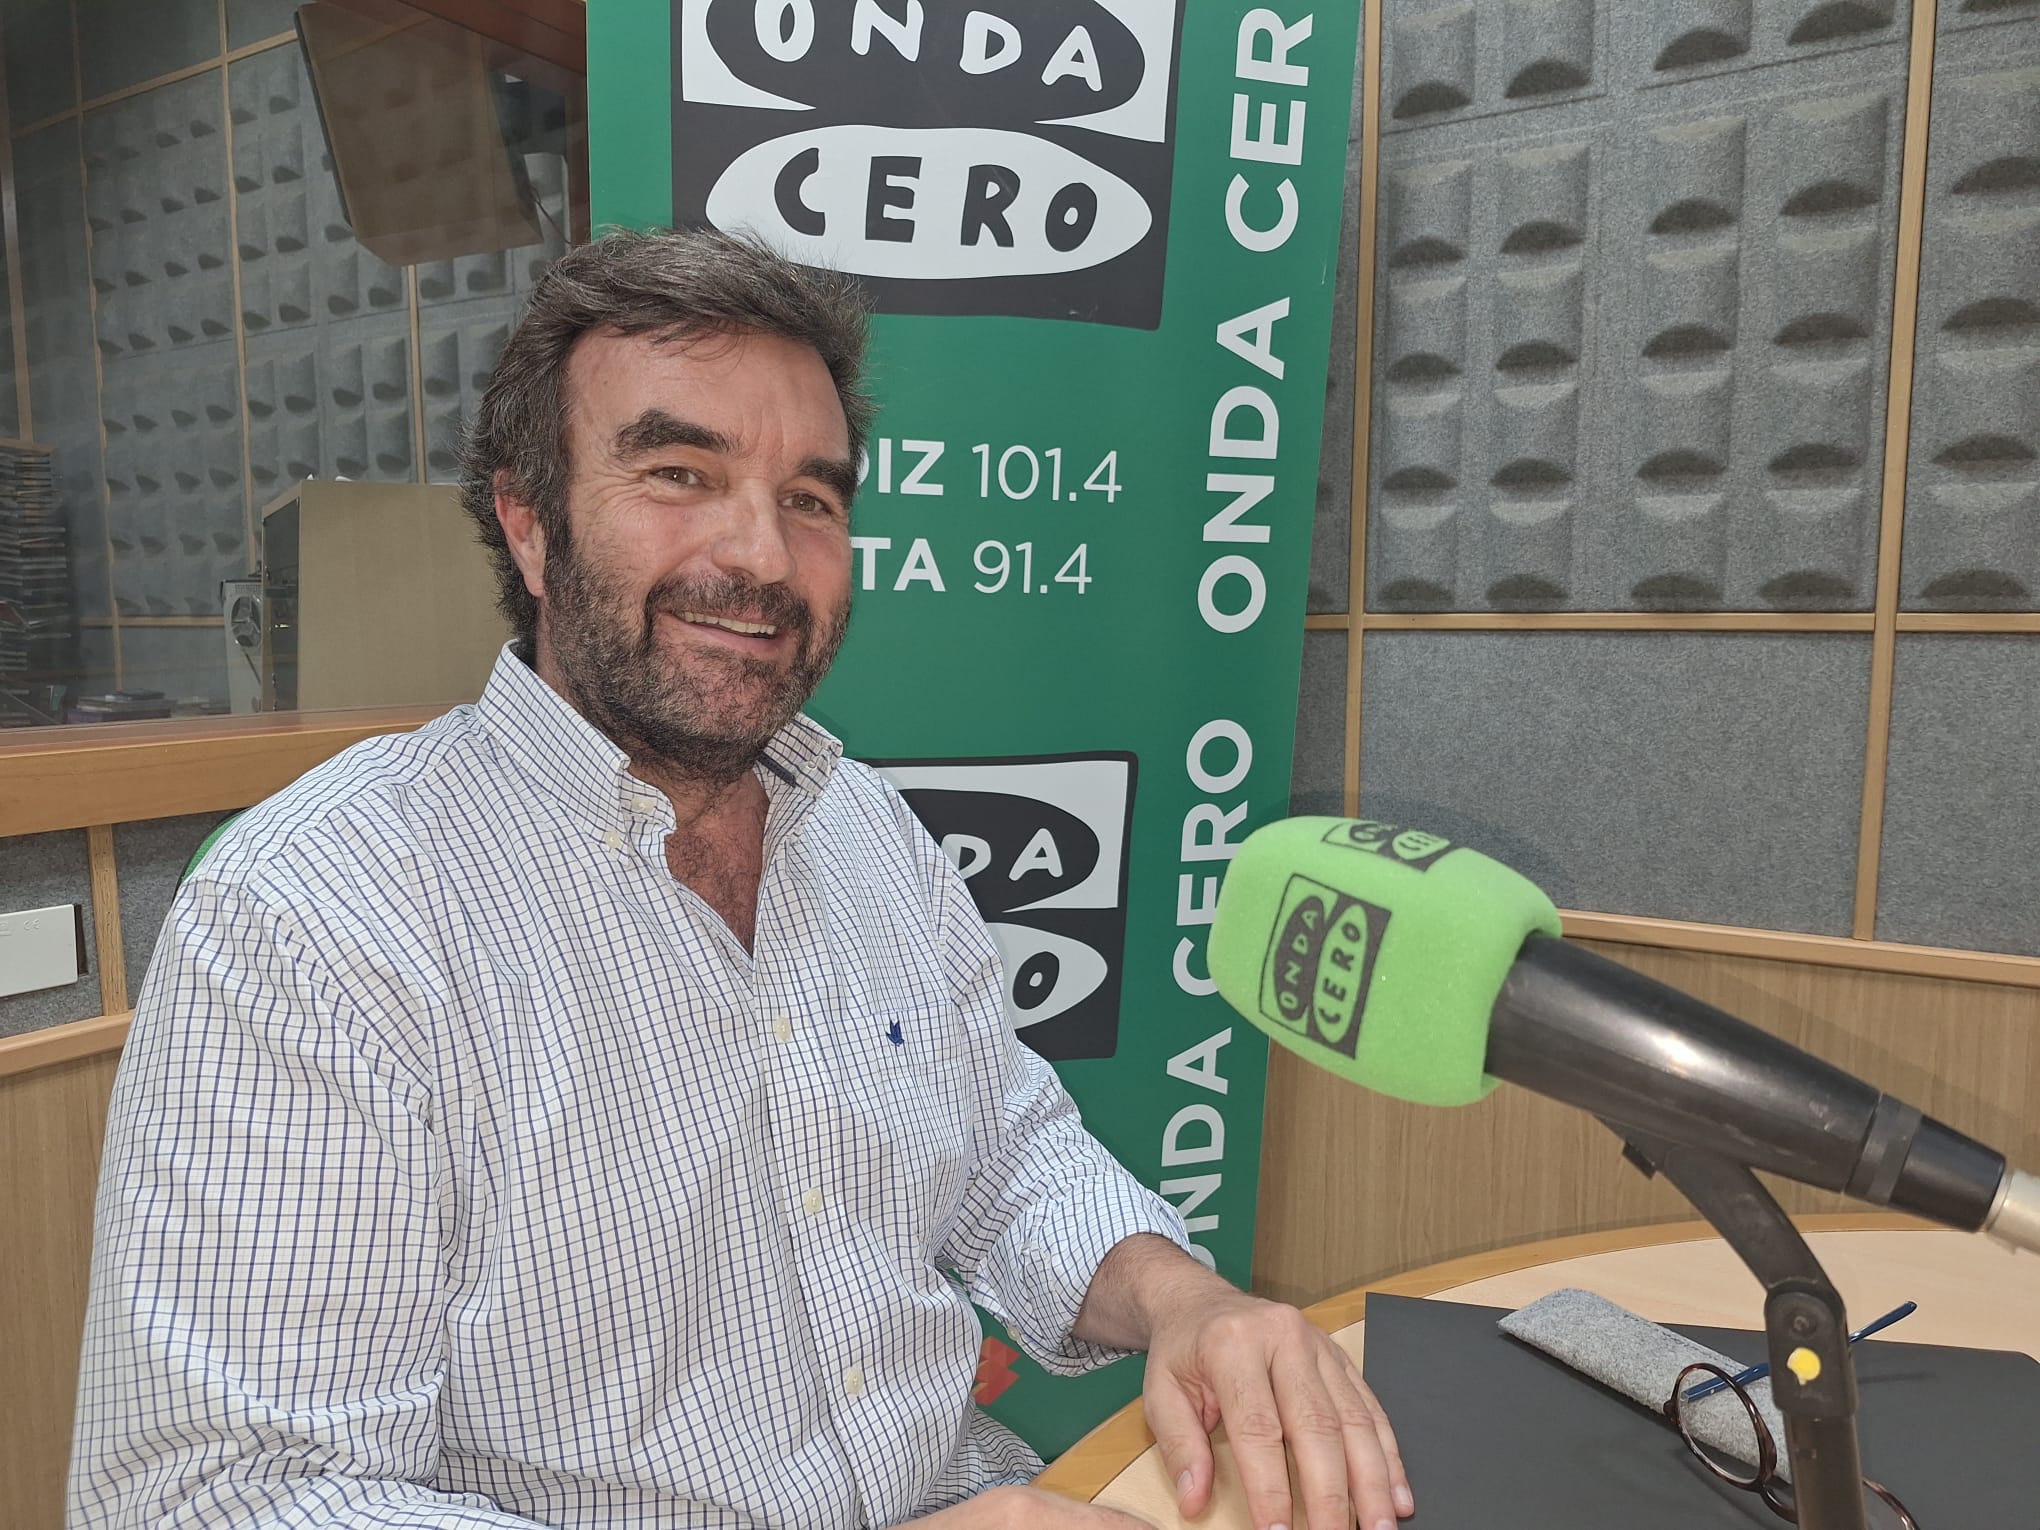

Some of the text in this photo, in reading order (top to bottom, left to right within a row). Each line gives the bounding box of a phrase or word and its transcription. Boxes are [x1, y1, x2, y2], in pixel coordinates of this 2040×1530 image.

[755, 0, 1102, 91] ONDA
[1225, 8, 1313, 253] CER
[774, 147, 1097, 252] CERO
[857, 438, 1122, 503] IZ 101.4
[1197, 296, 1290, 634] ONDA
[849, 536, 1092, 594] TA 91.4
[941, 828, 1063, 881] DA
[1279, 909, 1319, 1010] ONDA
[1319, 922, 1360, 1024] CERO
[1160, 1027, 1232, 1273] NDA
